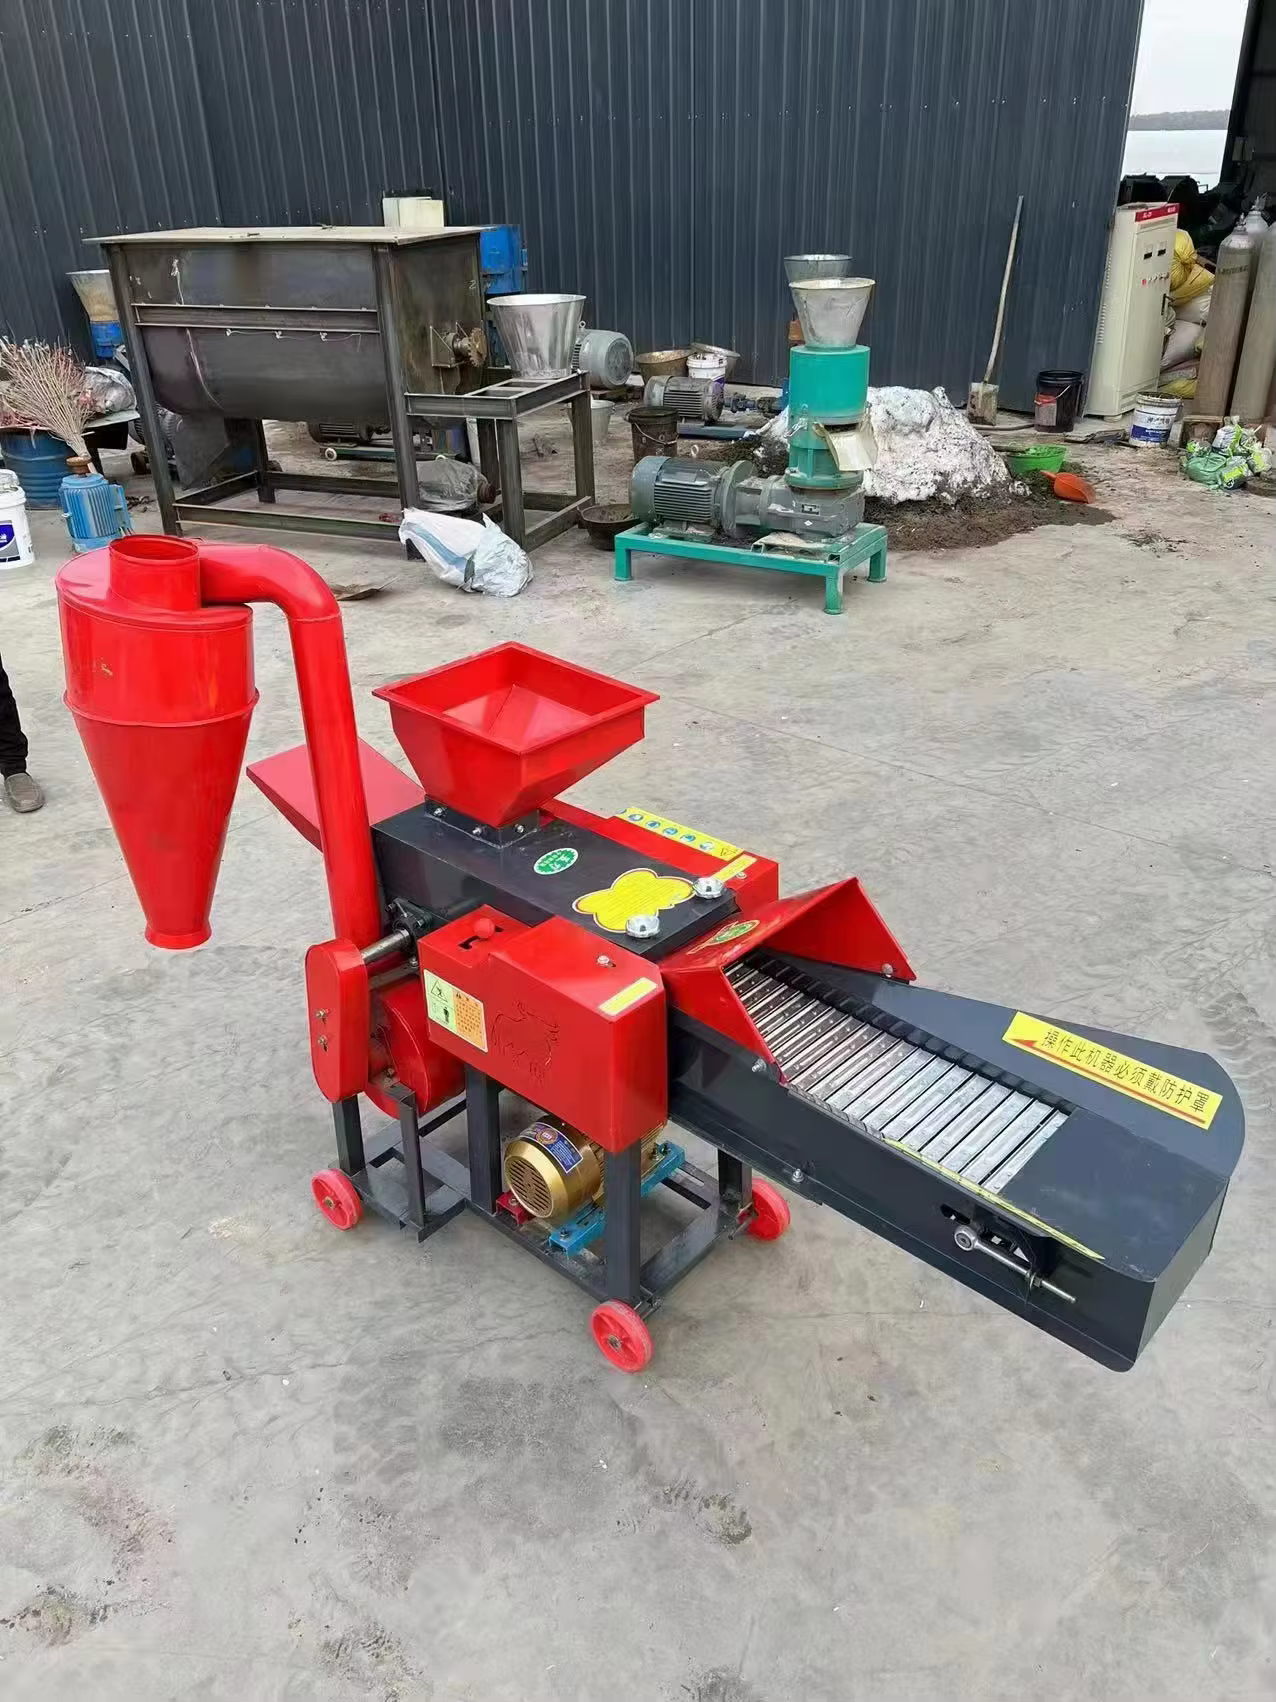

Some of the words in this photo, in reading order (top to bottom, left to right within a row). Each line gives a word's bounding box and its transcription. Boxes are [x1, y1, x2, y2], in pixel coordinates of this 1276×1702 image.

[1042, 1029, 1209, 1113] 操作此机器必须戴防护罩
